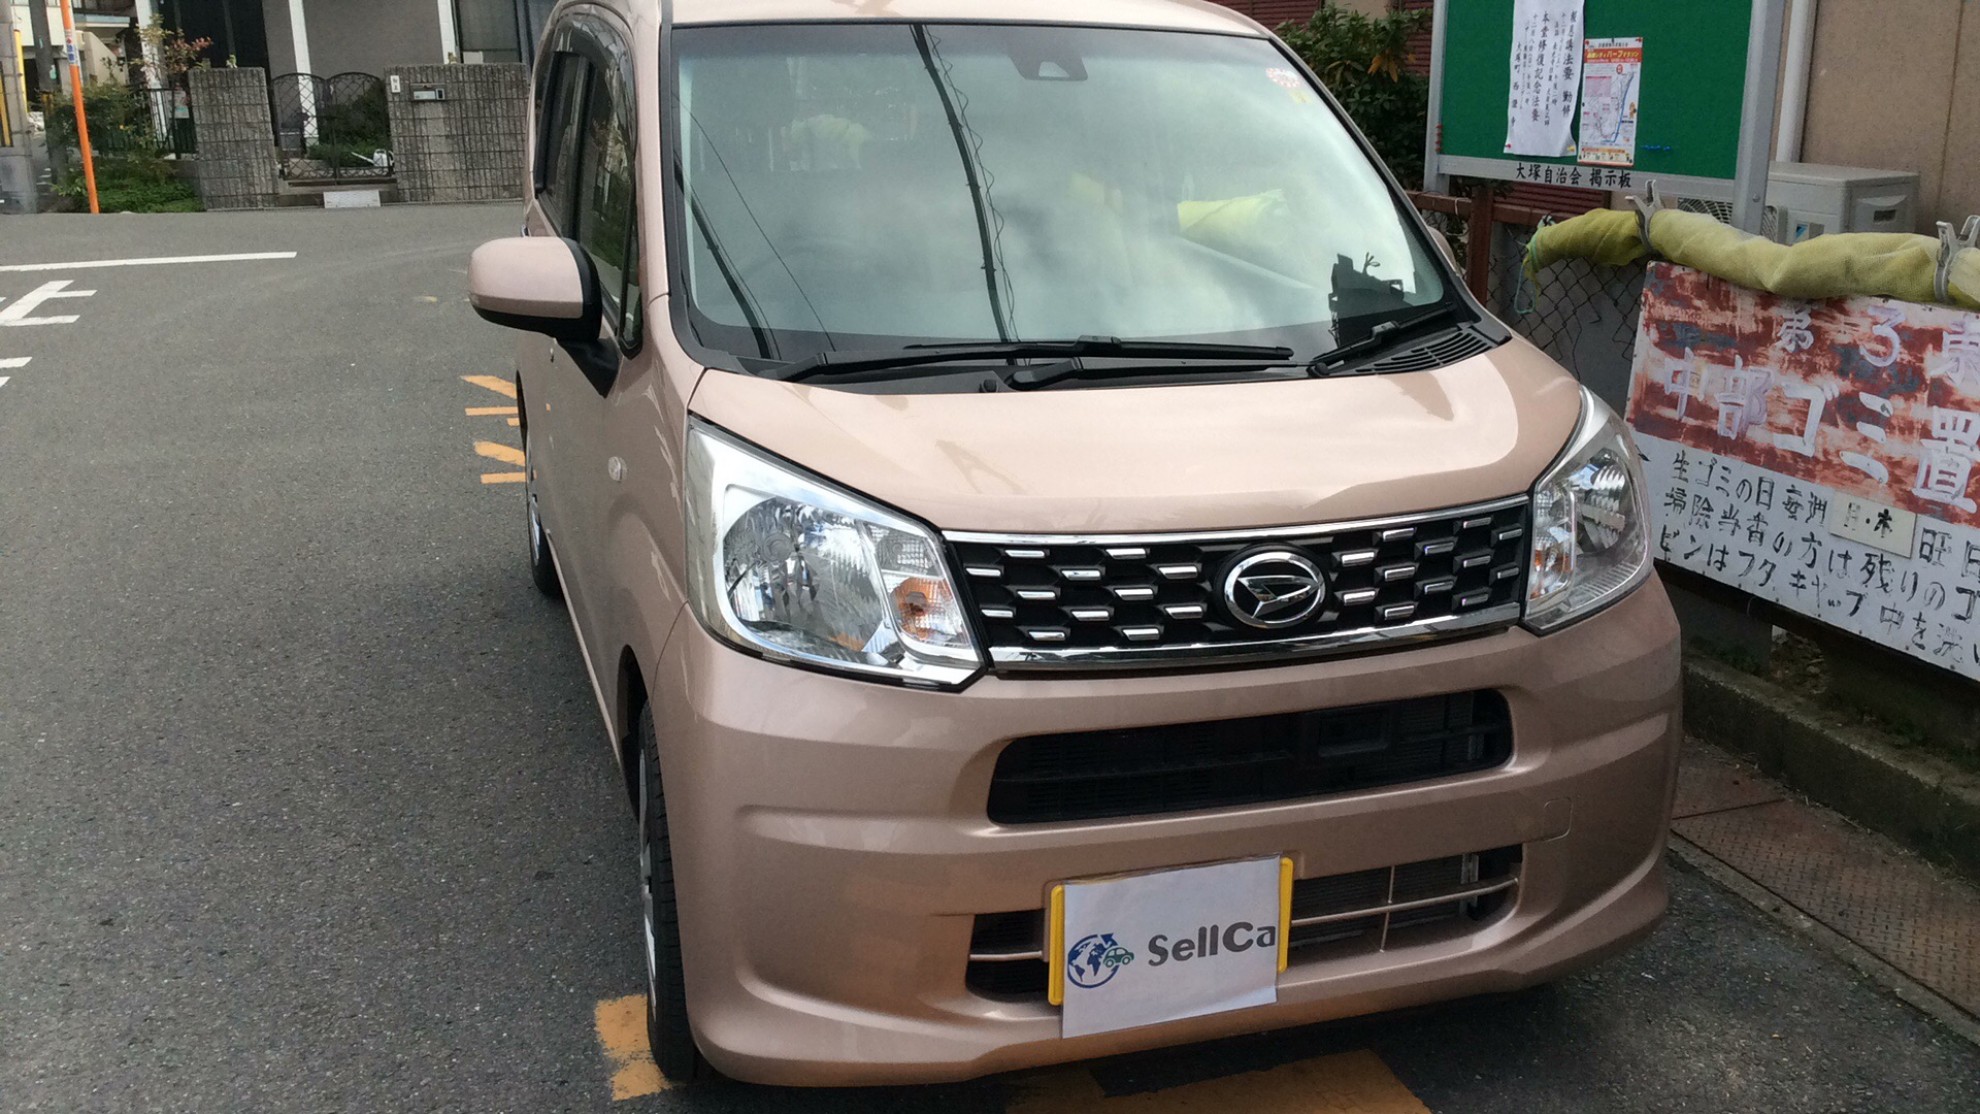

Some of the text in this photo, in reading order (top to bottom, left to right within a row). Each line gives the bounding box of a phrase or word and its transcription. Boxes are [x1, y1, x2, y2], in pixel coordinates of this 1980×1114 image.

[1516, 163, 1632, 188] 大塚自治会 掲示板
[1148, 921, 1276, 967] SellCa
